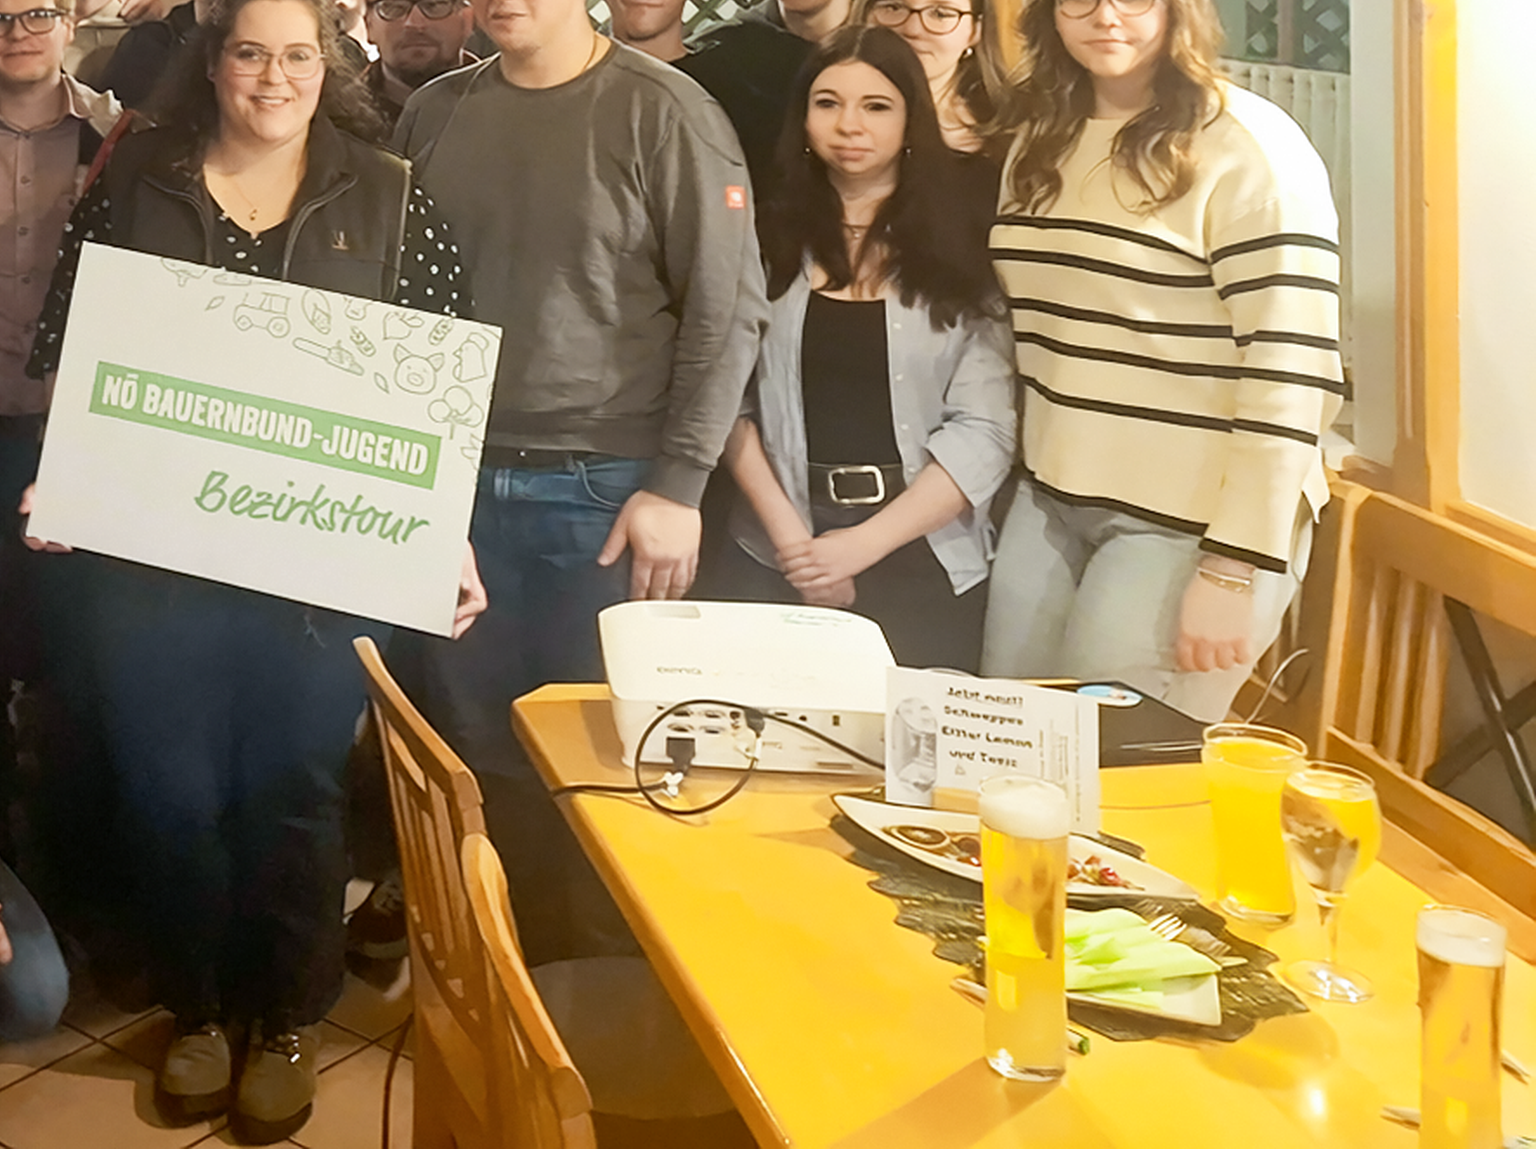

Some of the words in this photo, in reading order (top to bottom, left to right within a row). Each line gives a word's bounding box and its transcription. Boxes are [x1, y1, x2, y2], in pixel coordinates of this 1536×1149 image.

[101, 372, 139, 410] NÖ
[142, 383, 429, 476] BAUERNBUND-JUGEND
[194, 470, 431, 545] Bezirkstour
